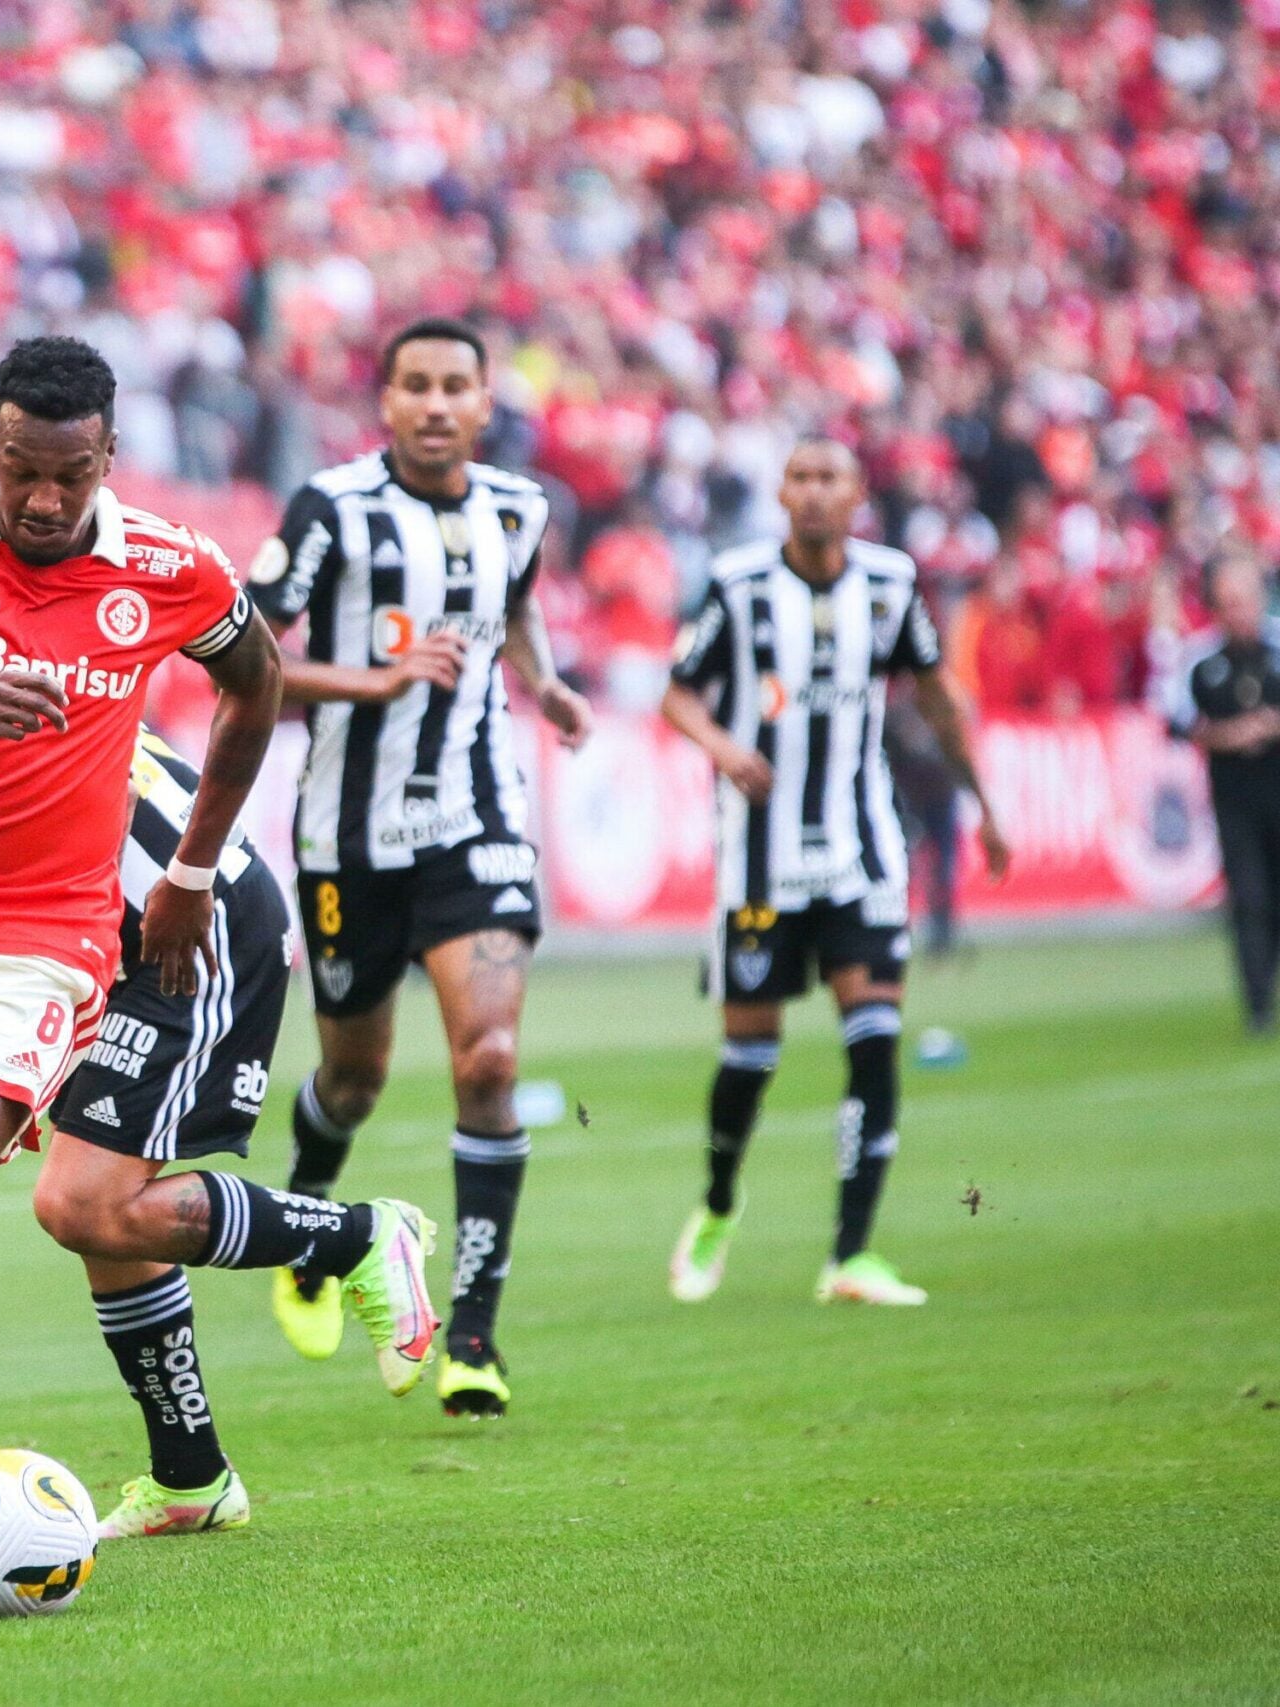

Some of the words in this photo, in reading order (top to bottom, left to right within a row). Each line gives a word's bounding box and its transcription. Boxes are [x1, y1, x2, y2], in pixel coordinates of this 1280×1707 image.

[126, 543, 195, 568] ESTRELA
[149, 561, 182, 578] BET
[316, 881, 342, 936] 8
[37, 1001, 65, 1045] 8
[5, 1056, 43, 1081] adidas
[87, 1040, 147, 1080] RUCK
[233, 1060, 269, 1102] ab
[83, 1107, 121, 1128] adidas
[138, 1347, 157, 1369] de
[163, 1326, 212, 1434] TODOS
